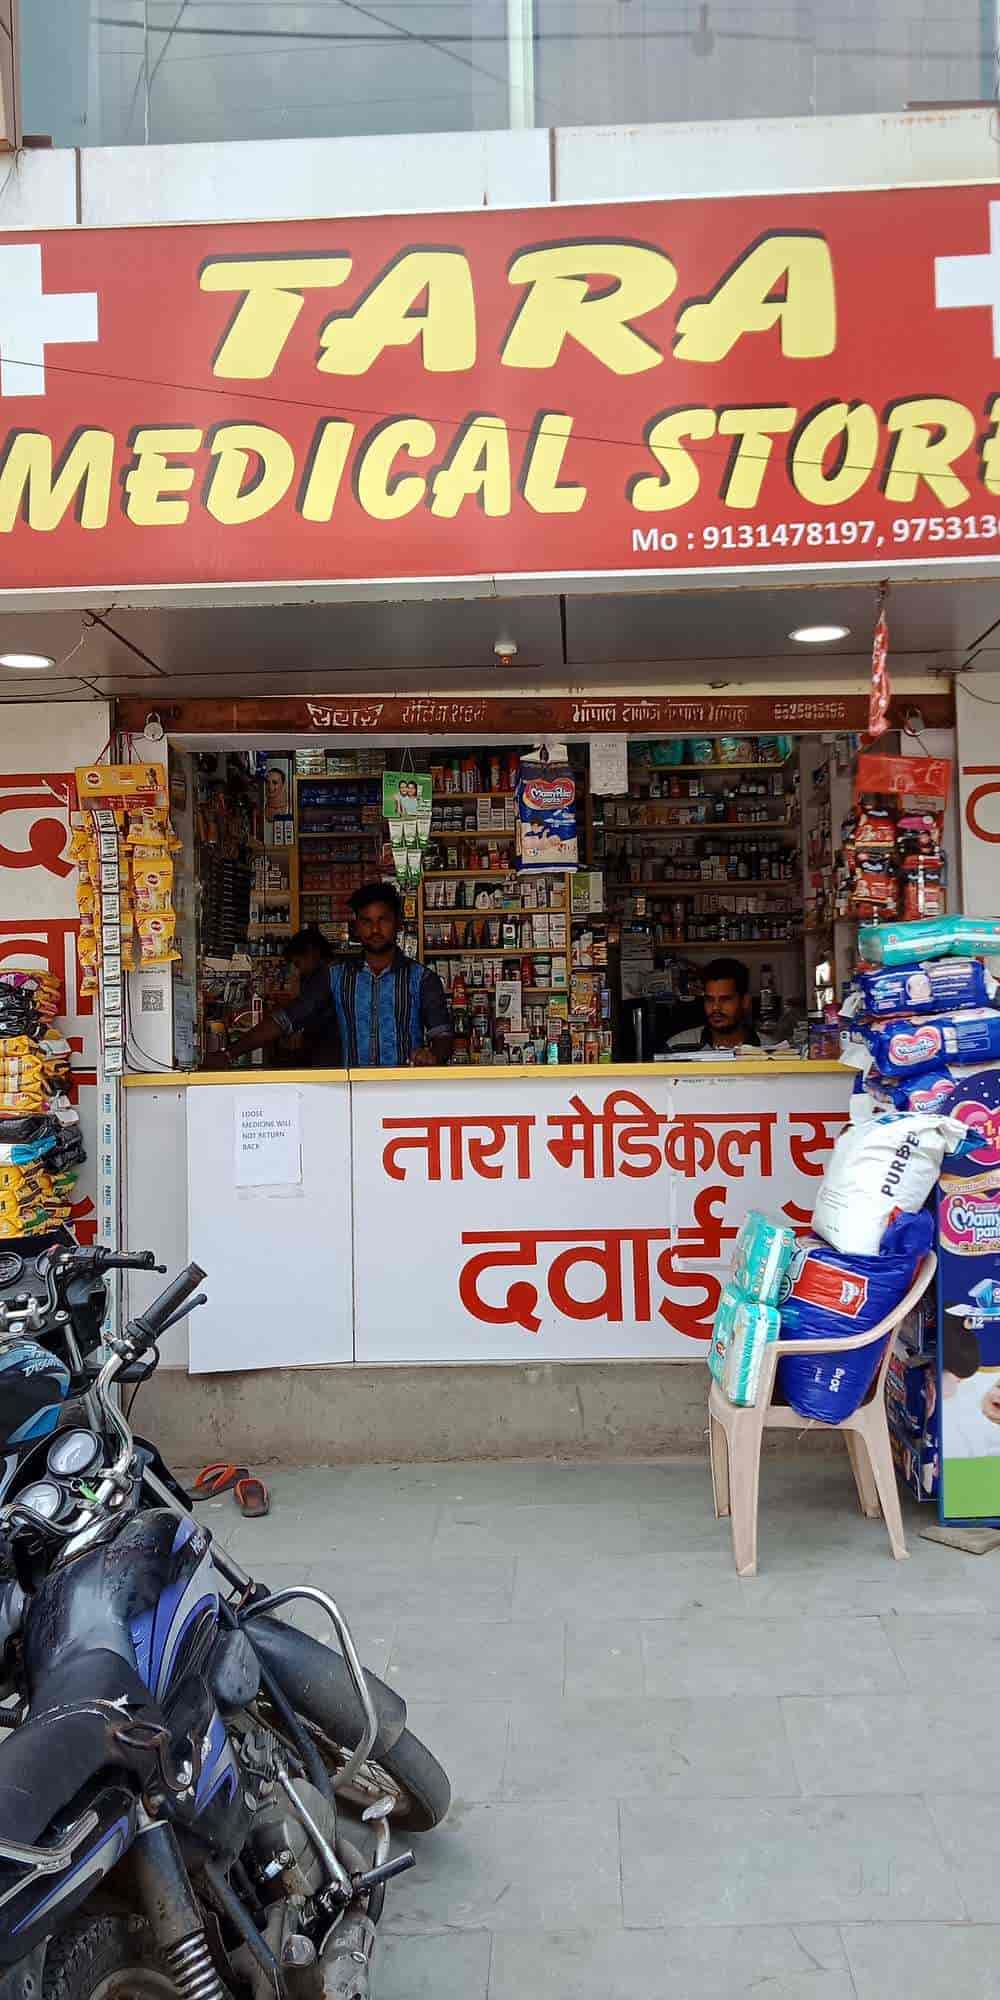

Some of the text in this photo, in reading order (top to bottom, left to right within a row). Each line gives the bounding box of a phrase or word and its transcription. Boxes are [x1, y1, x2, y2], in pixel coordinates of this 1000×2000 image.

[199, 232, 837, 381] TARA
[0, 414, 588, 535] MEDICAL
[631, 528, 678, 552] Mo
[702, 520, 885, 550] 9131478197,
[381, 1114, 537, 1182] तारा
[546, 1089, 778, 1180] मेडिकल
